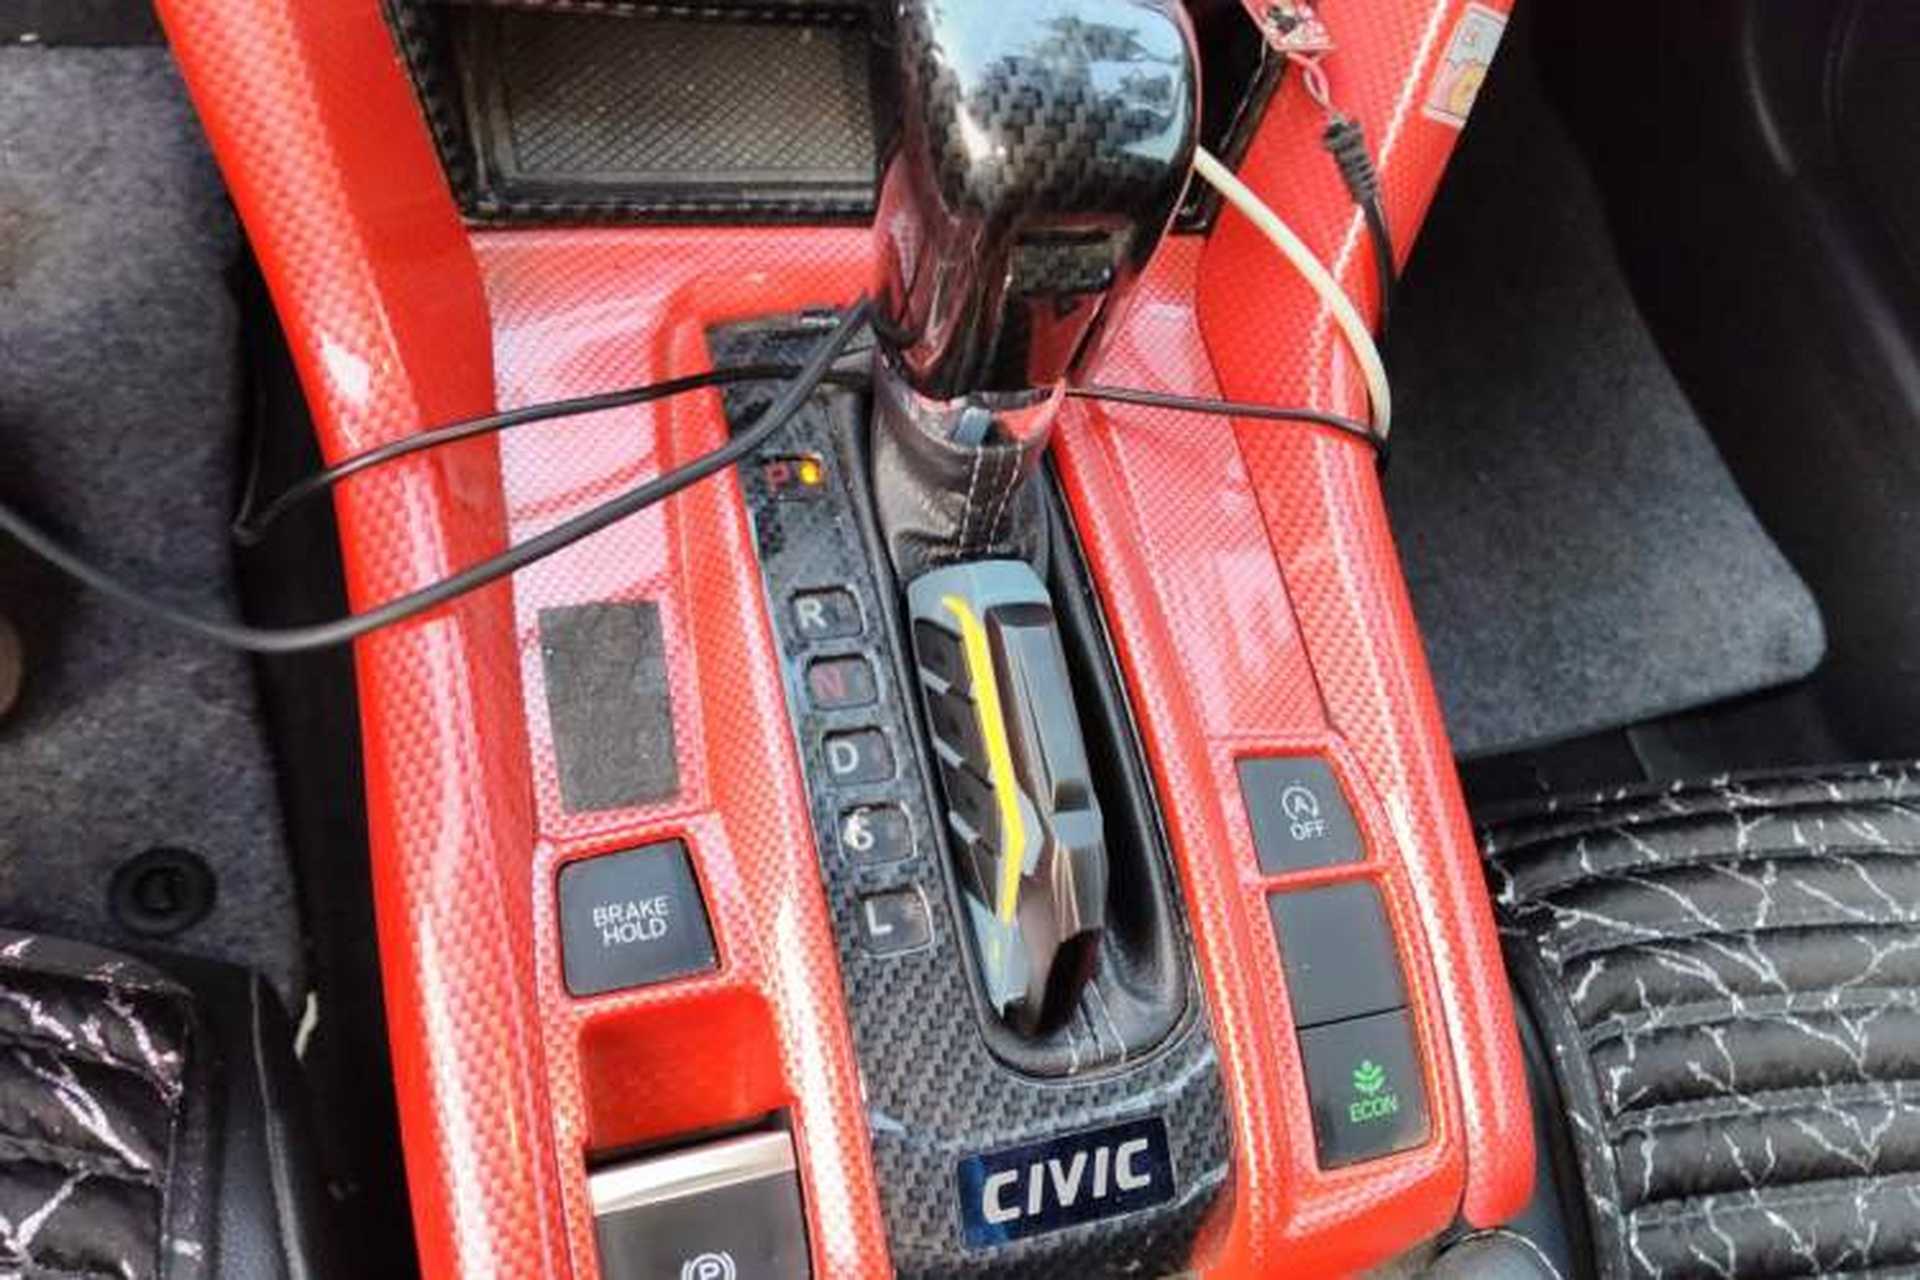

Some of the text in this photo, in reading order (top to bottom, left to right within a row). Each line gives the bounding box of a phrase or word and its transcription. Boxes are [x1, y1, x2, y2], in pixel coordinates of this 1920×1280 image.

[765, 463, 789, 494] P
[799, 598, 827, 628] R
[813, 664, 845, 698] N
[830, 740, 860, 774] D
[1290, 819, 1325, 841] OFF
[592, 895, 670, 929] BRAKE
[864, 899, 894, 935] L
[602, 917, 668, 947] HOLD
[1350, 1093, 1398, 1122] ECON
[982, 1138, 1151, 1225] CIVIC
